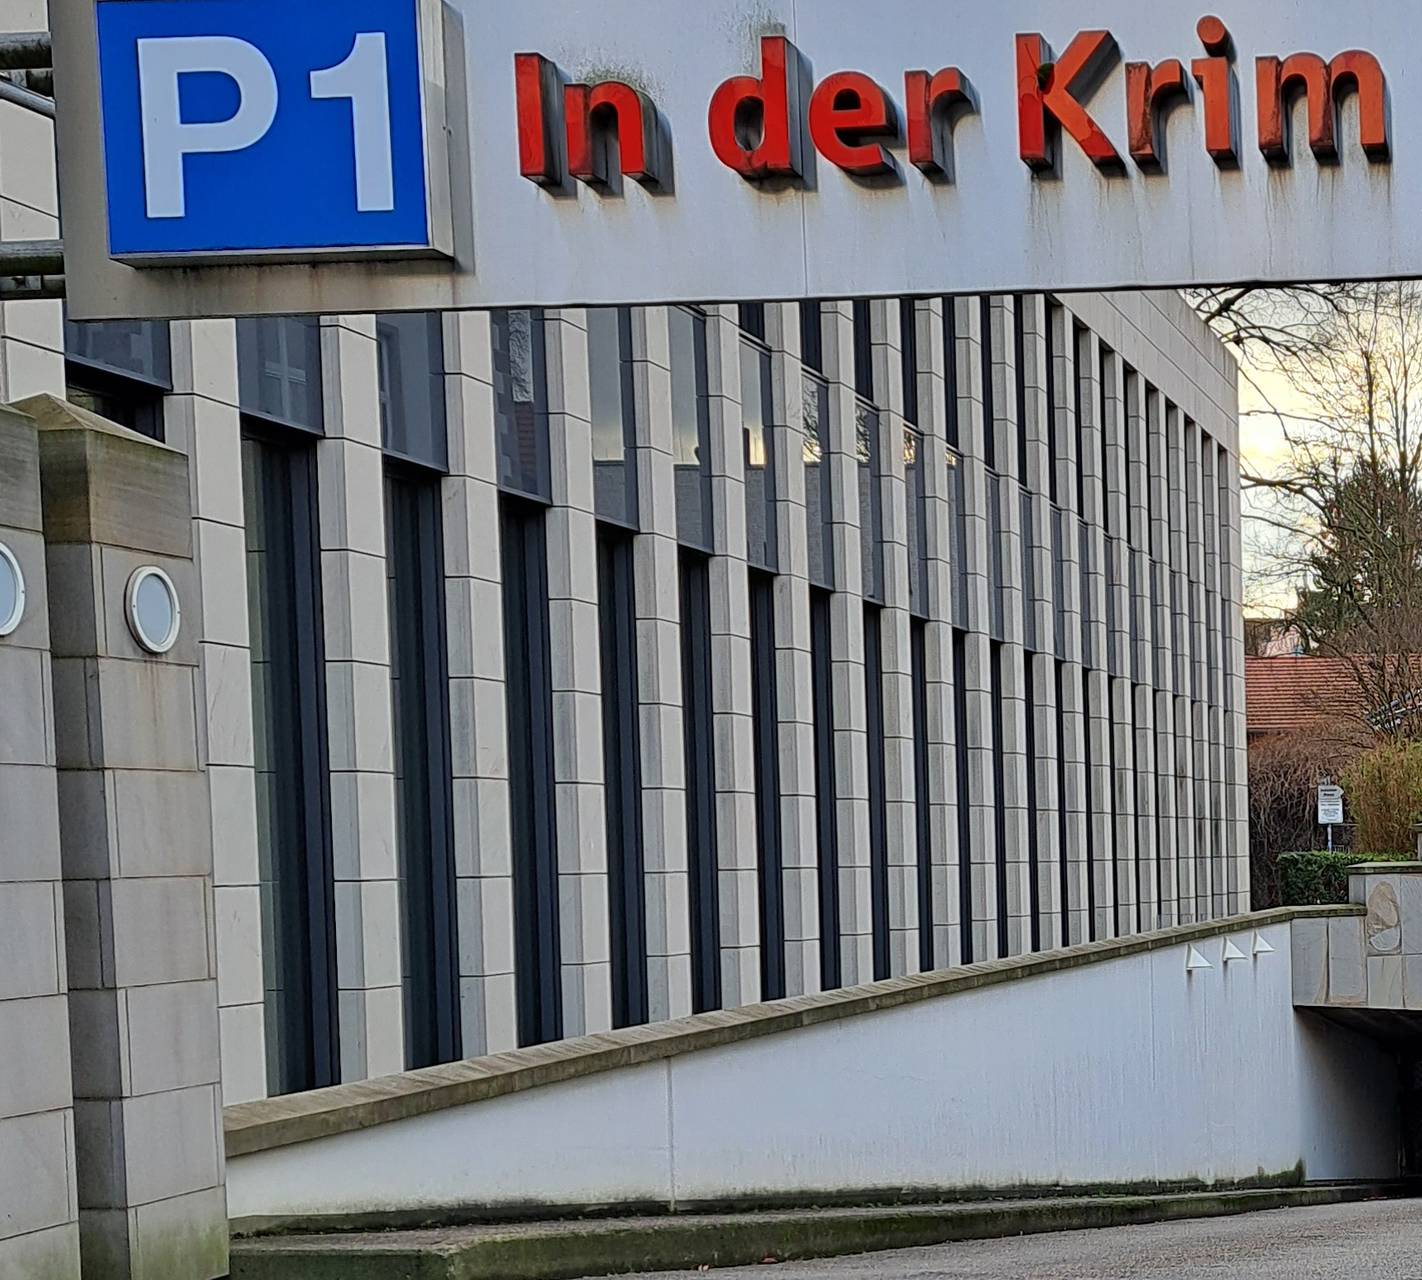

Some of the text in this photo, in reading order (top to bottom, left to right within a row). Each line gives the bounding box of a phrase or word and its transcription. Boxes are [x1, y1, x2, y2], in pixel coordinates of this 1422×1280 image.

[138, 33, 396, 219] P1
[514, 16, 1390, 184] In der Krim
